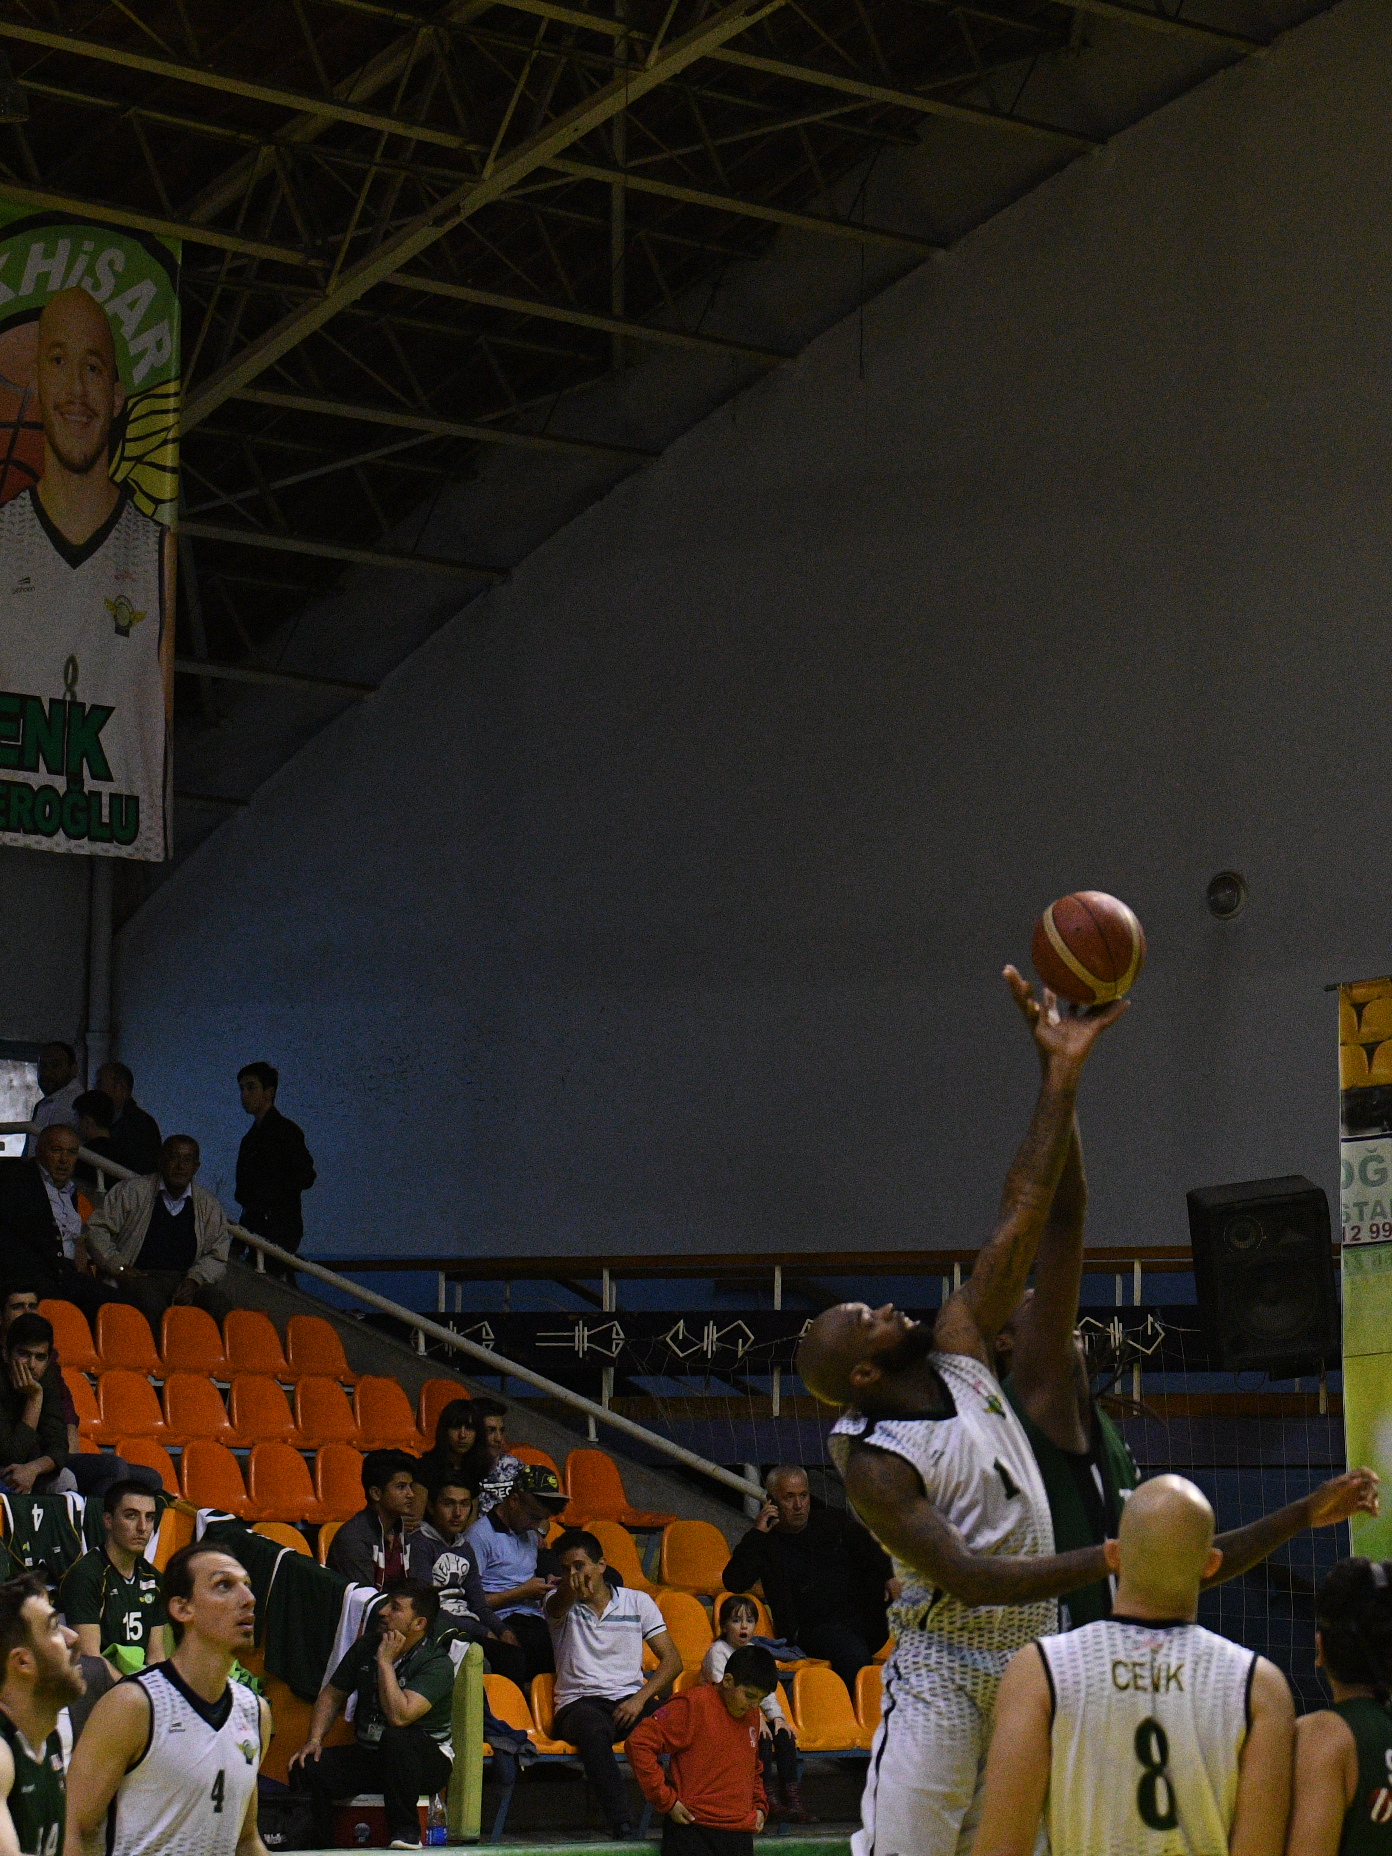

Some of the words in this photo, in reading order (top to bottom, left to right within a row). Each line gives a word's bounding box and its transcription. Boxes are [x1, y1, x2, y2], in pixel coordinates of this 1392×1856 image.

[1369, 1222, 1392, 1240] 99
[994, 1457, 1022, 1500] 1
[31, 1503, 44, 1532] 4
[122, 1611, 144, 1641] 15
[212, 1769, 226, 1813] 4
[1134, 1717, 1178, 1830] 8
